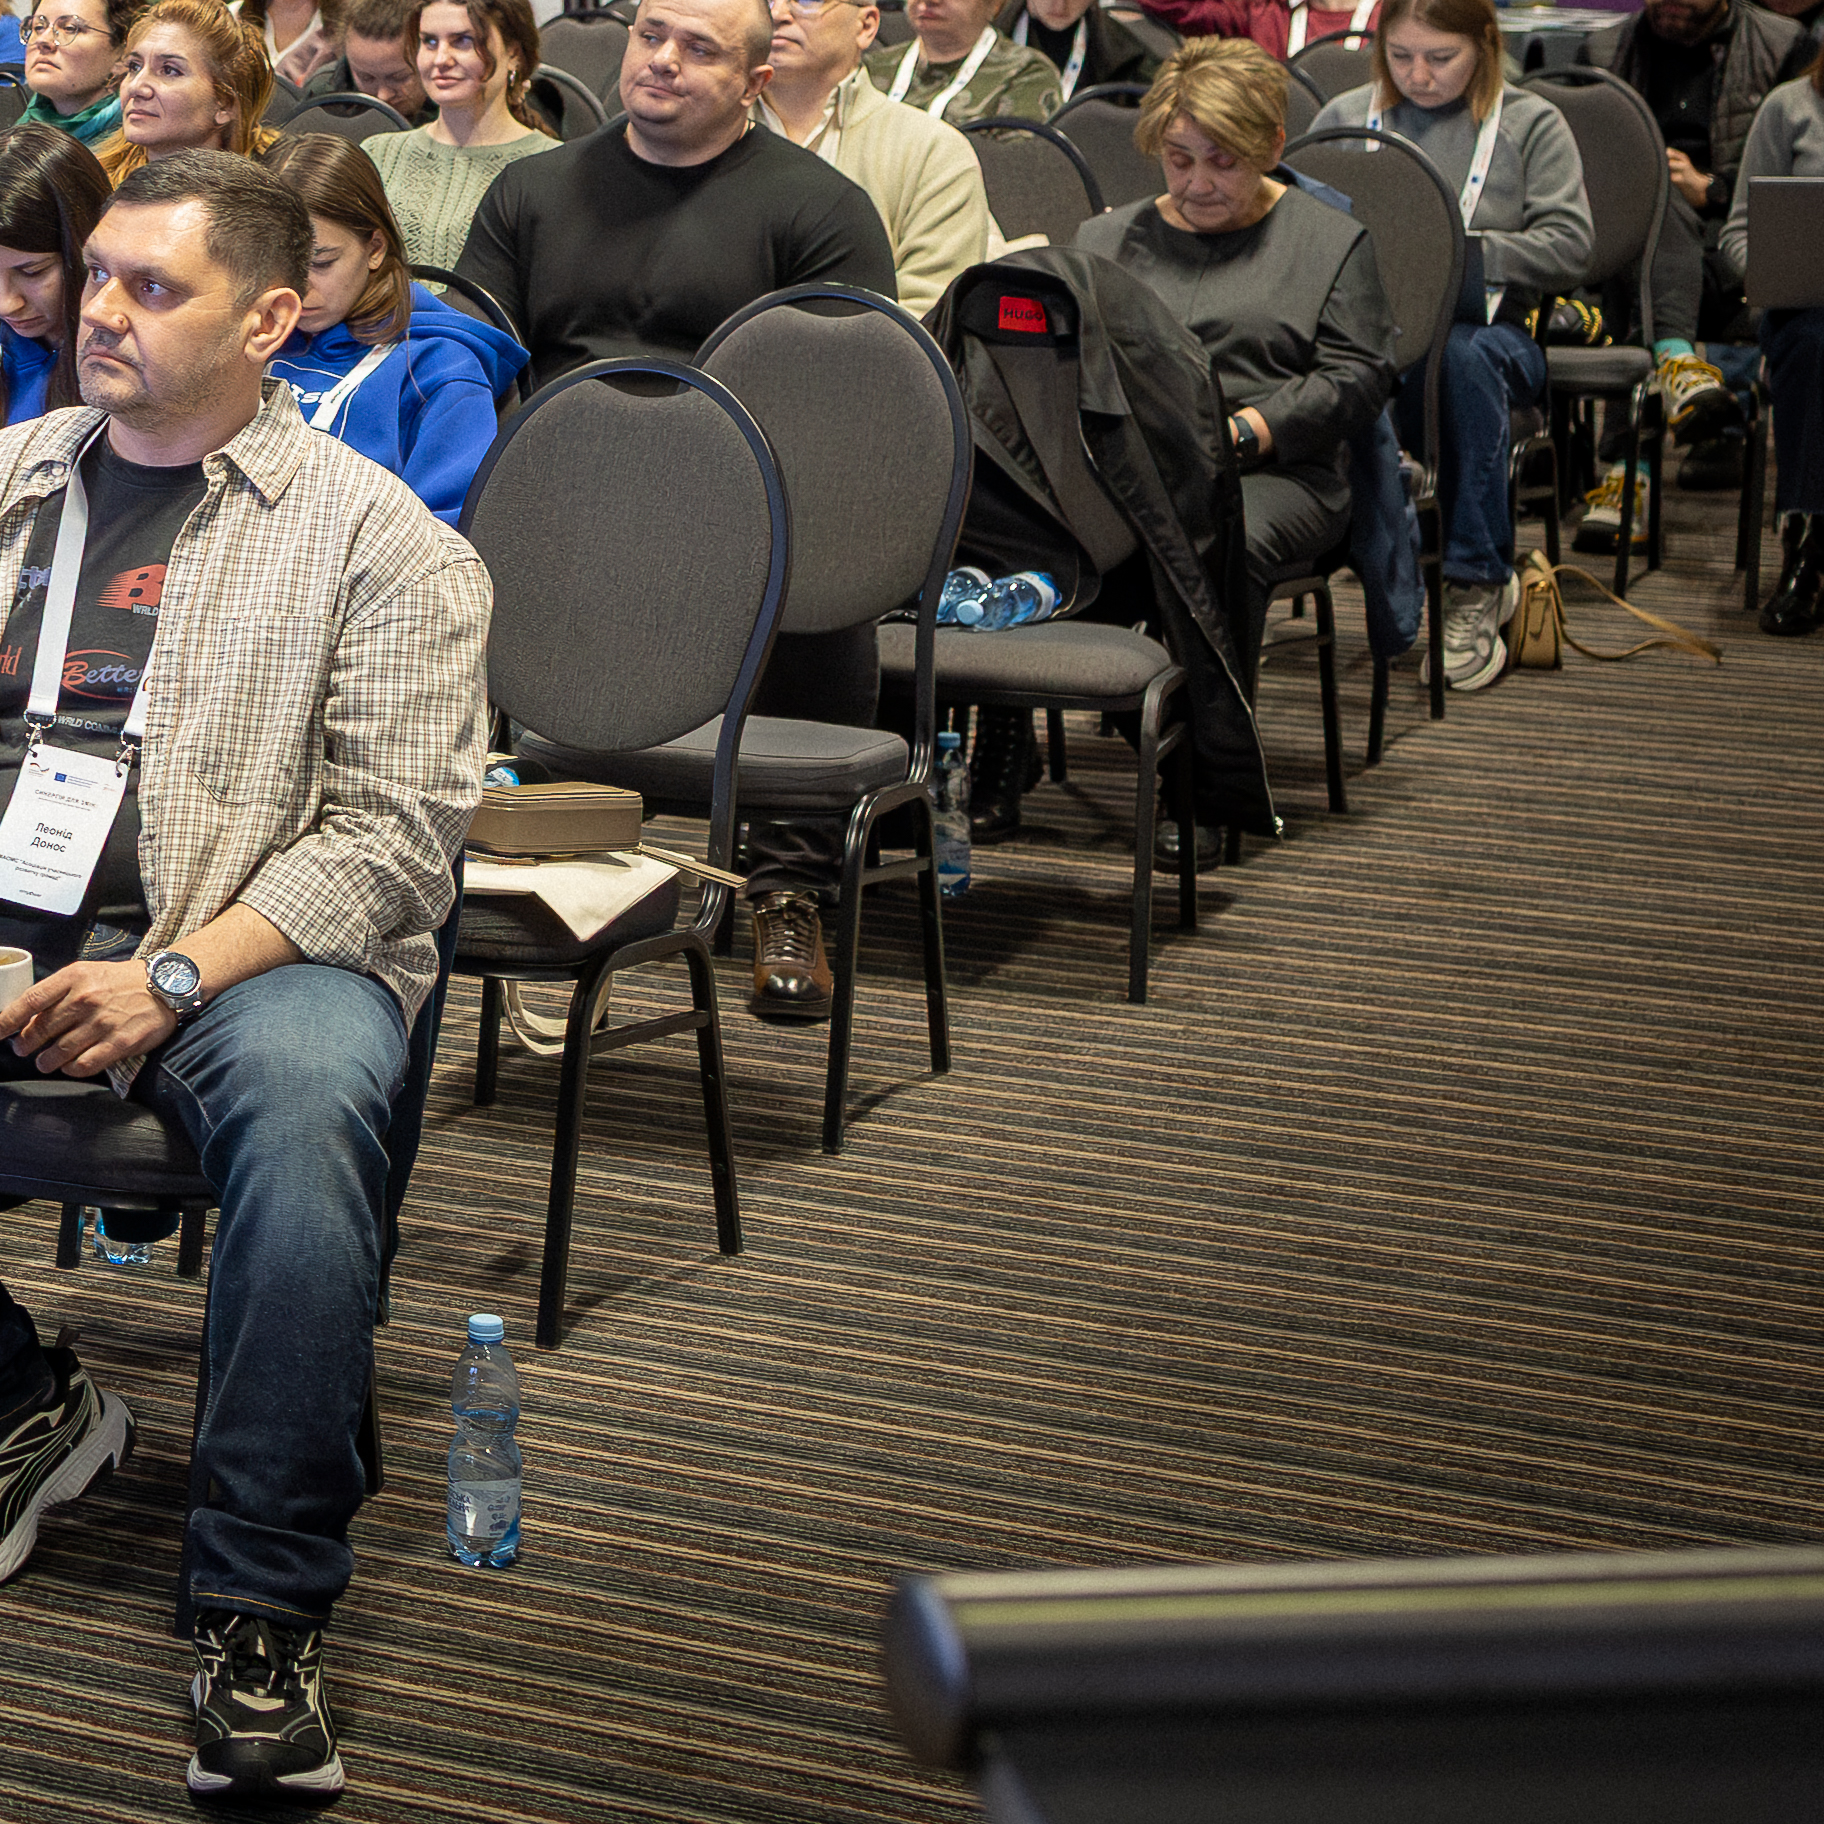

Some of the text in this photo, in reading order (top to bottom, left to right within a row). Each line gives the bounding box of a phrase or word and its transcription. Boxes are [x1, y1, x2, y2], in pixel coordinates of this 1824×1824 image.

[1003, 308, 1044, 321] HUGO
[35, 822, 73, 840] Леонід
[30, 836, 67, 853] Донос
